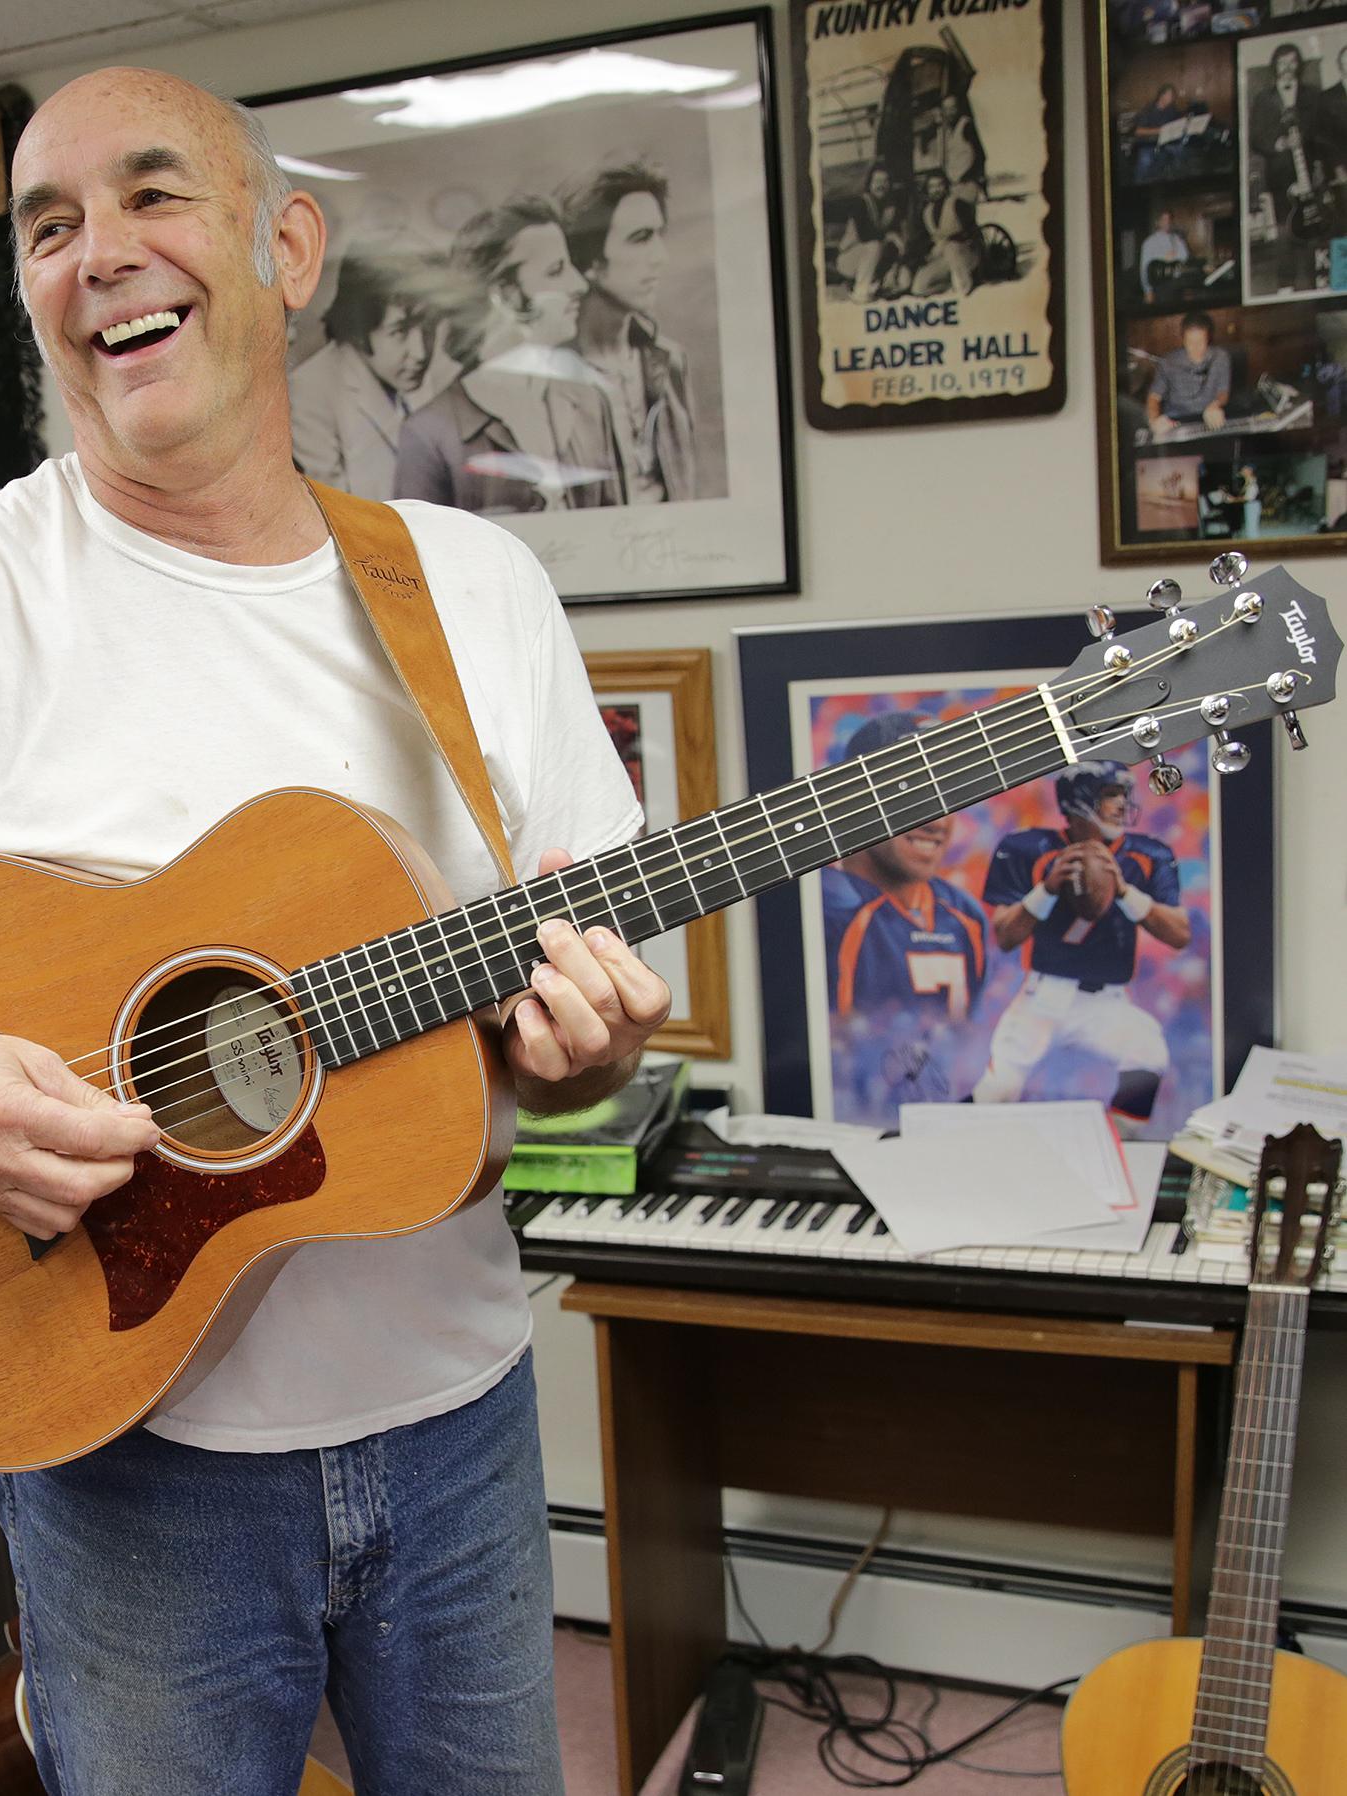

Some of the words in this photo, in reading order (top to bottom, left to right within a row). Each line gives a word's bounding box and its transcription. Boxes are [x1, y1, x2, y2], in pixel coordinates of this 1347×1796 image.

[814, 0, 920, 40] KUNTRY
[864, 301, 959, 333] DANCE
[833, 340, 945, 373] LEADER
[961, 332, 1040, 362] HALL
[871, 374, 923, 399] FEB.
[969, 364, 1026, 389] 1979
[352, 559, 422, 592] Taylor
[1278, 599, 1317, 664] Taylor
[255, 1022, 283, 1077] Taylor
